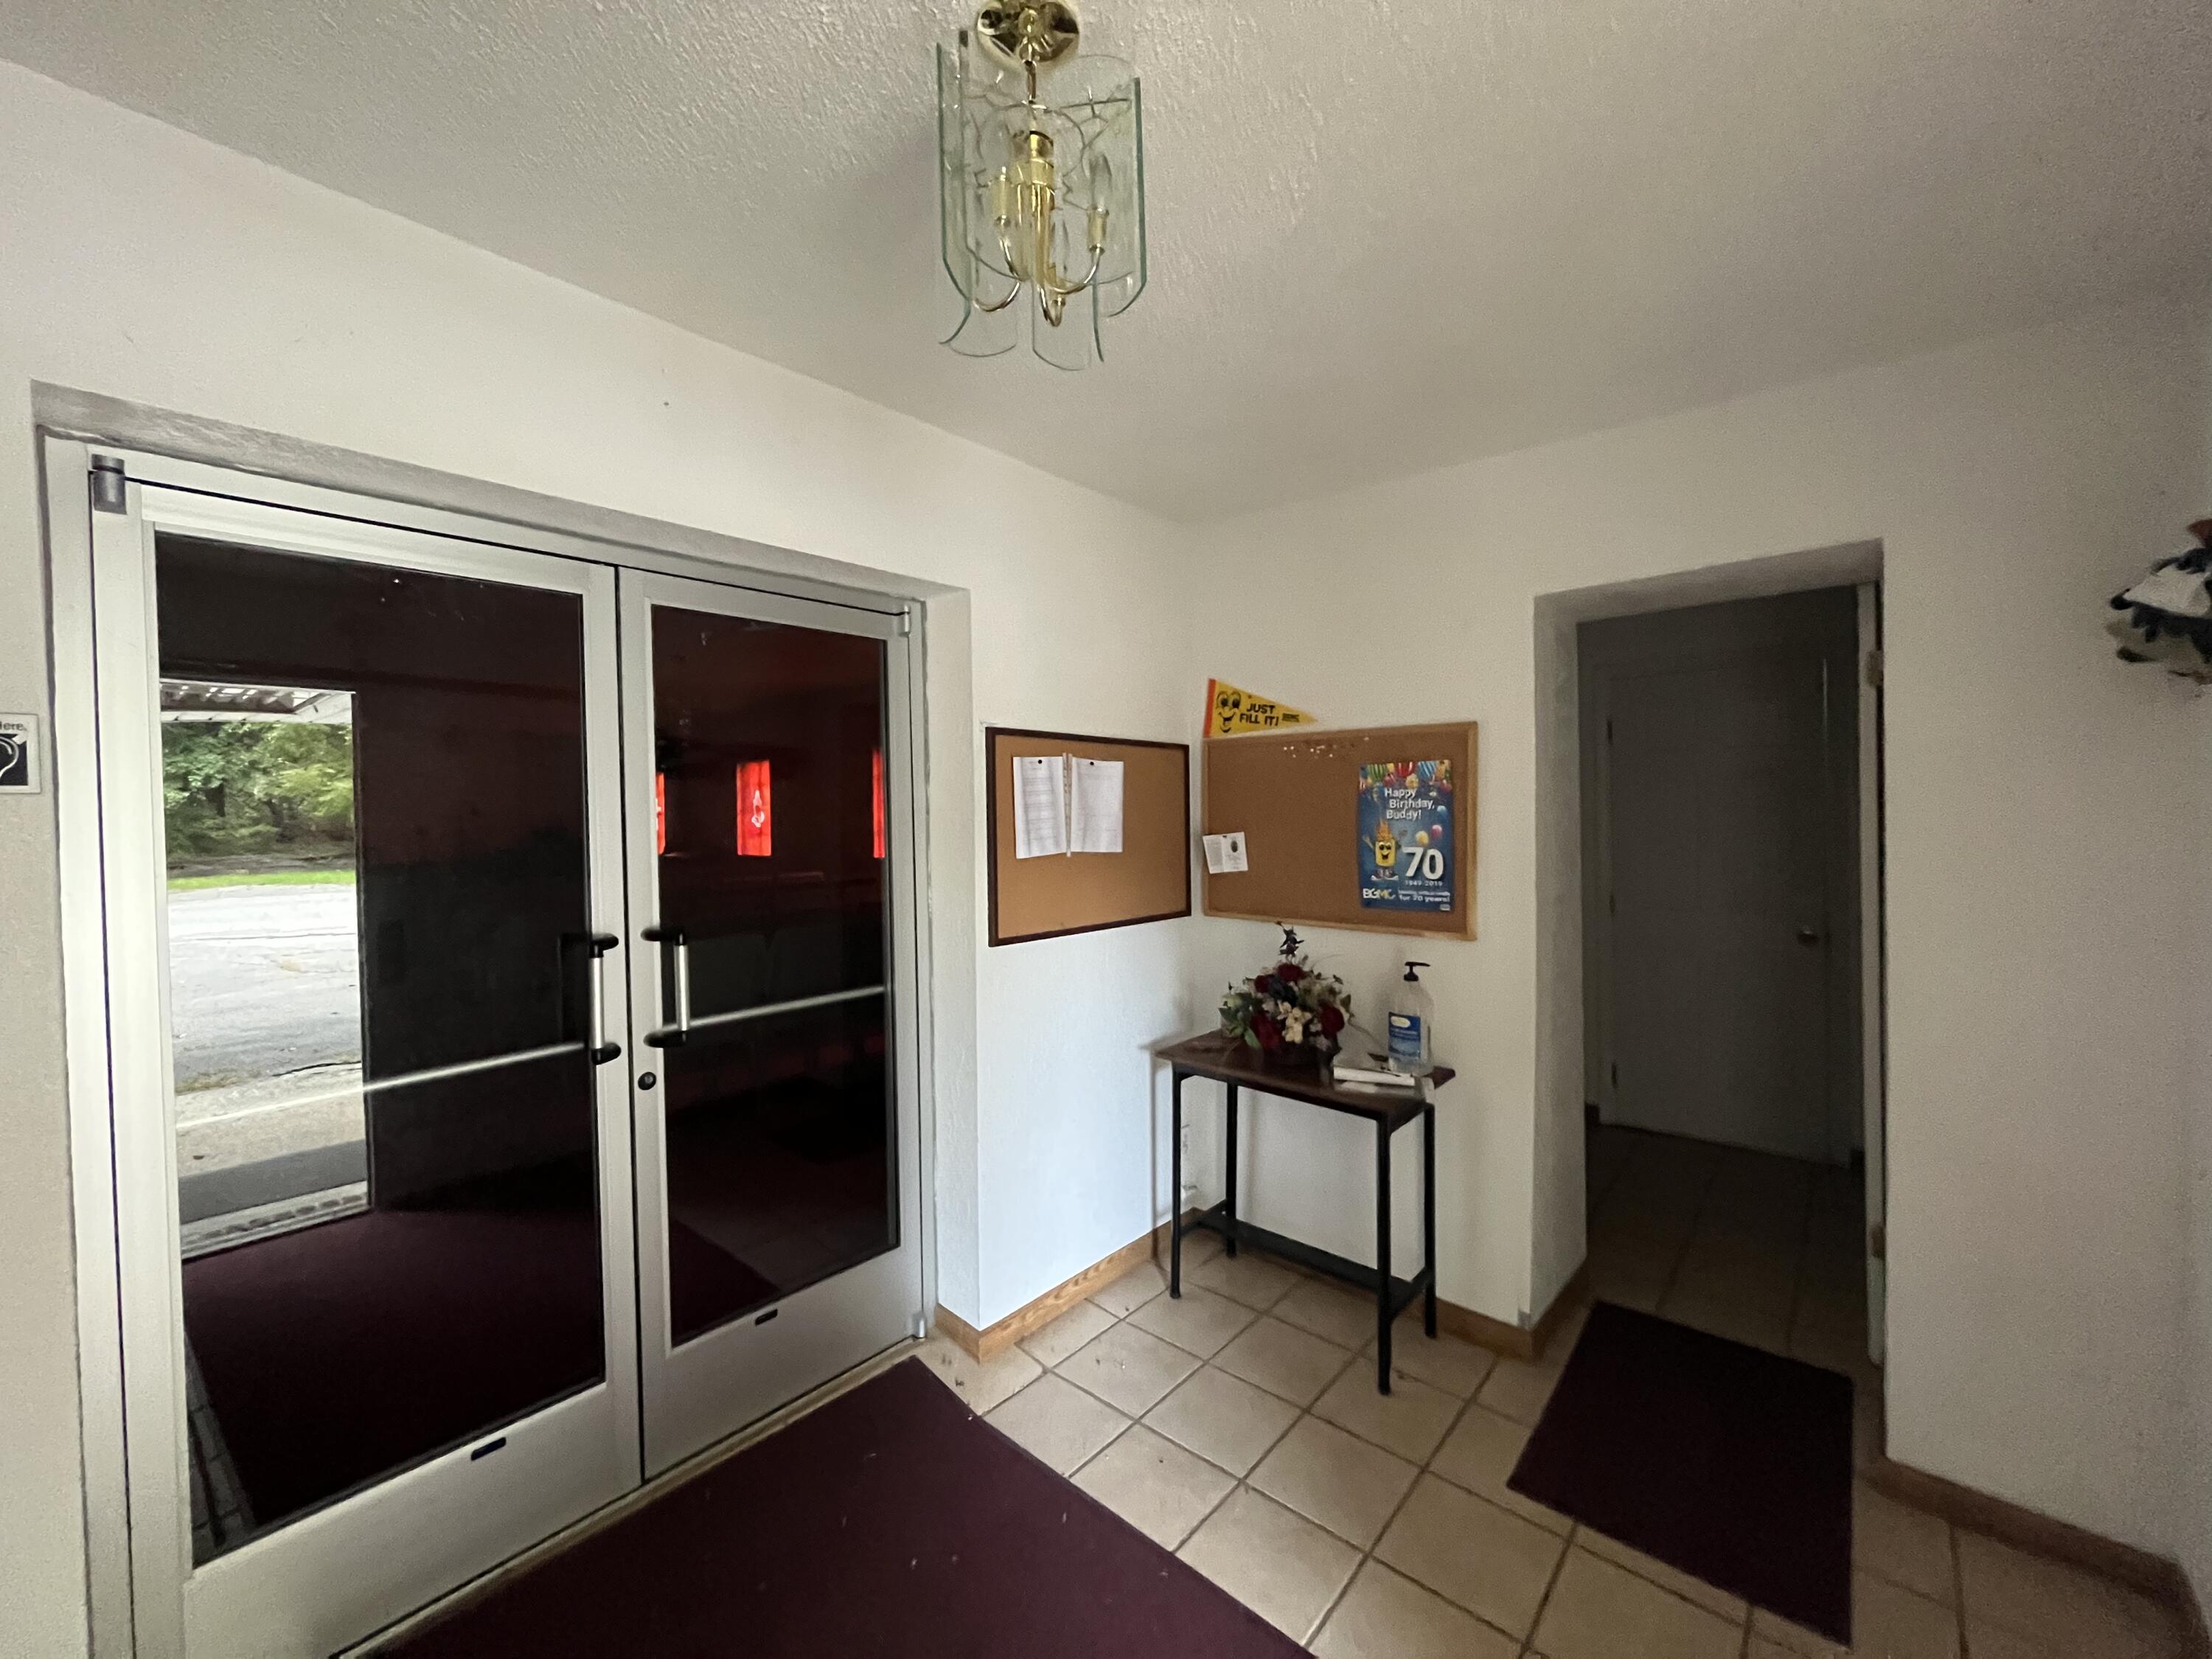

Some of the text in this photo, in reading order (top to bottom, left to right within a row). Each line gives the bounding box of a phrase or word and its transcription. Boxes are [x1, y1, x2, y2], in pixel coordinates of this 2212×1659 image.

[1247, 703, 1276, 714] JUST
[1239, 713, 1260, 724] FILL
[1265, 715, 1279, 726] IT!
[1384, 787, 1416, 799] Happy
[1389, 799, 1435, 810] Birthday,
[1386, 808, 1422, 821] Buddy!
[1402, 846, 1444, 880] 70
[1363, 888, 1395, 900] BGMC
